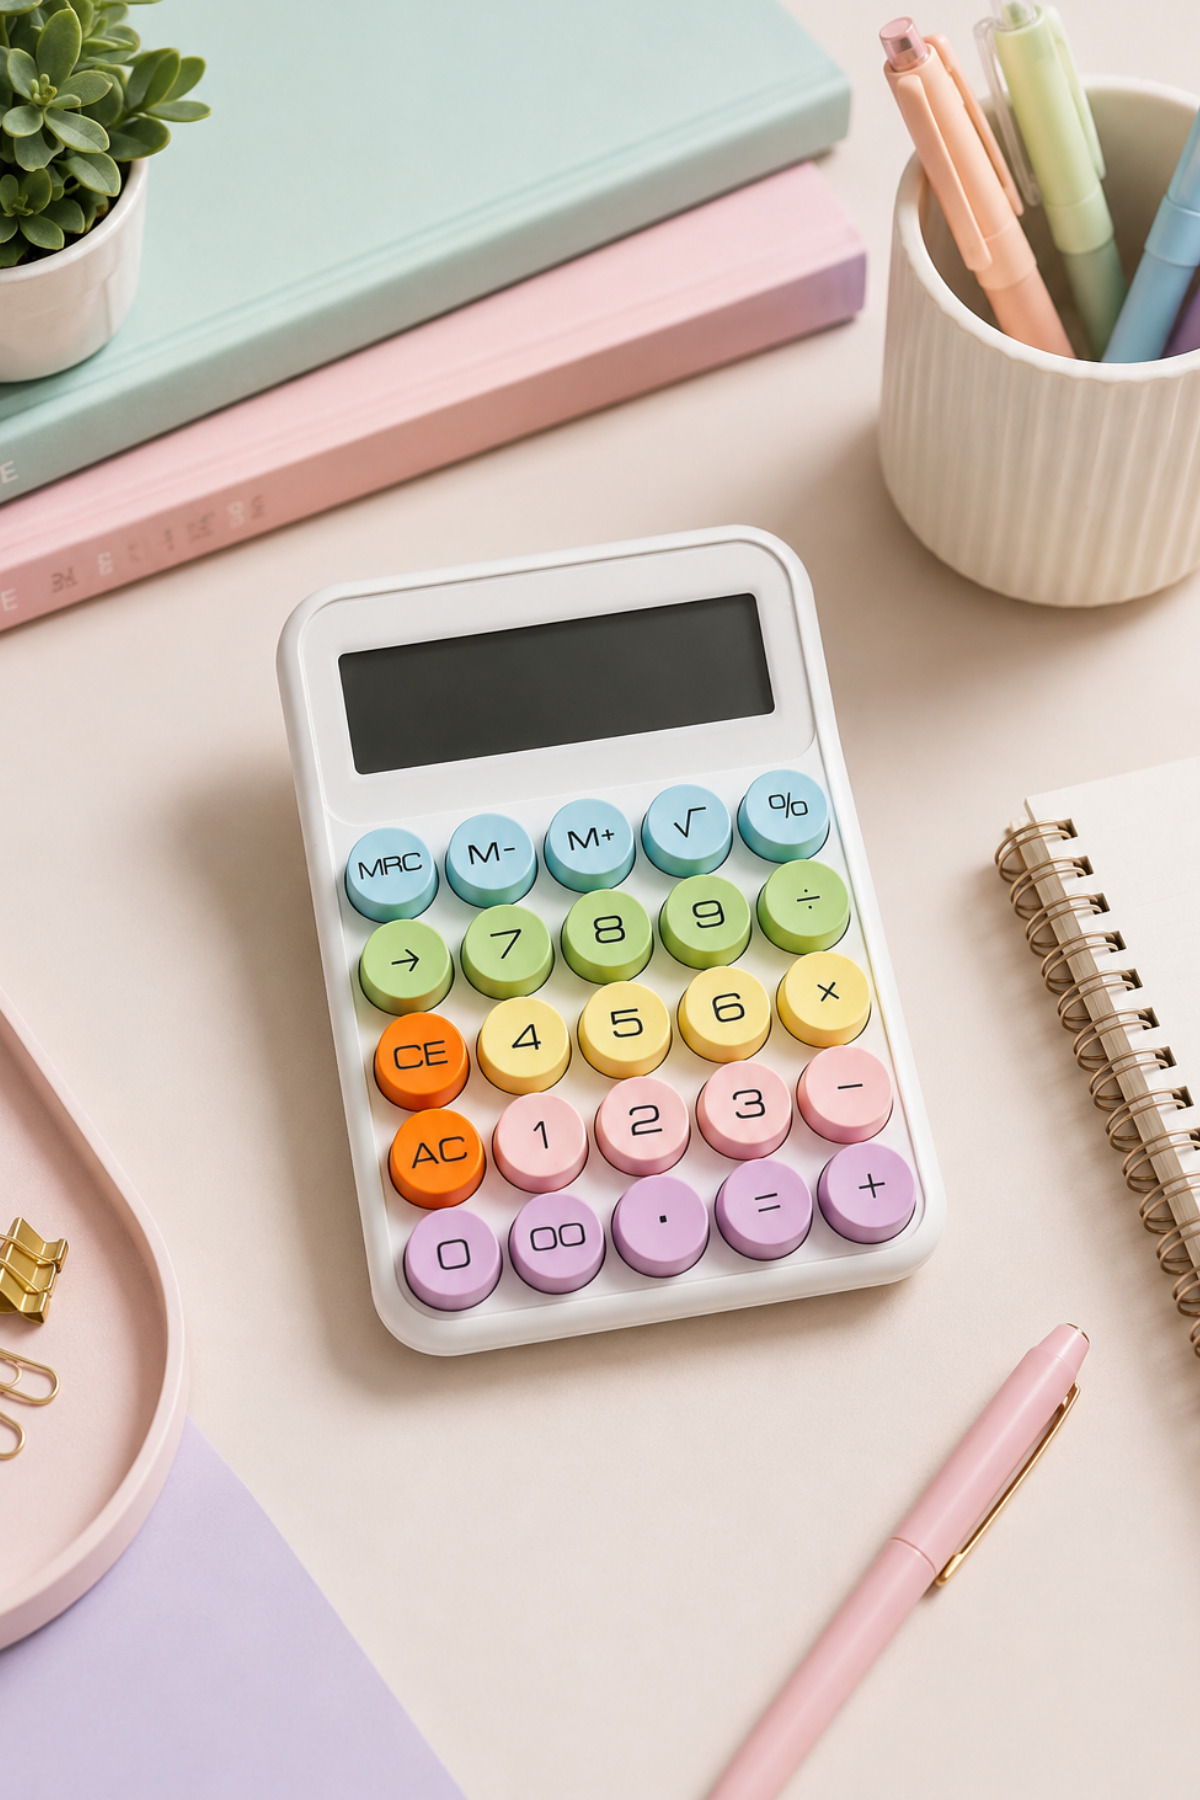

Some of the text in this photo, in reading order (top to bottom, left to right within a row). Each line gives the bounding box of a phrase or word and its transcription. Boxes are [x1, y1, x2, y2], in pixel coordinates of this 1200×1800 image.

[357, 852, 423, 880] MRC
[467, 841, 516, 865] M-
[567, 827, 615, 851] M+
[768, 792, 809, 819] %
[489, 888, 821, 960] 7 8 9 ÷
[393, 1040, 449, 1070] CE
[511, 1023, 542, 1051] 4
[610, 1008, 644, 1038] 5
[712, 992, 745, 1023] 6
[411, 1136, 468, 1169] AC
[533, 1120, 549, 1149] 1
[628, 1104, 663, 1136] 2
[732, 1088, 766, 1119] 3
[436, 1238, 471, 1271] 0
[529, 1222, 586, 1252] 00
[754, 1192, 781, 1213] =
[858, 1173, 886, 1199] +
